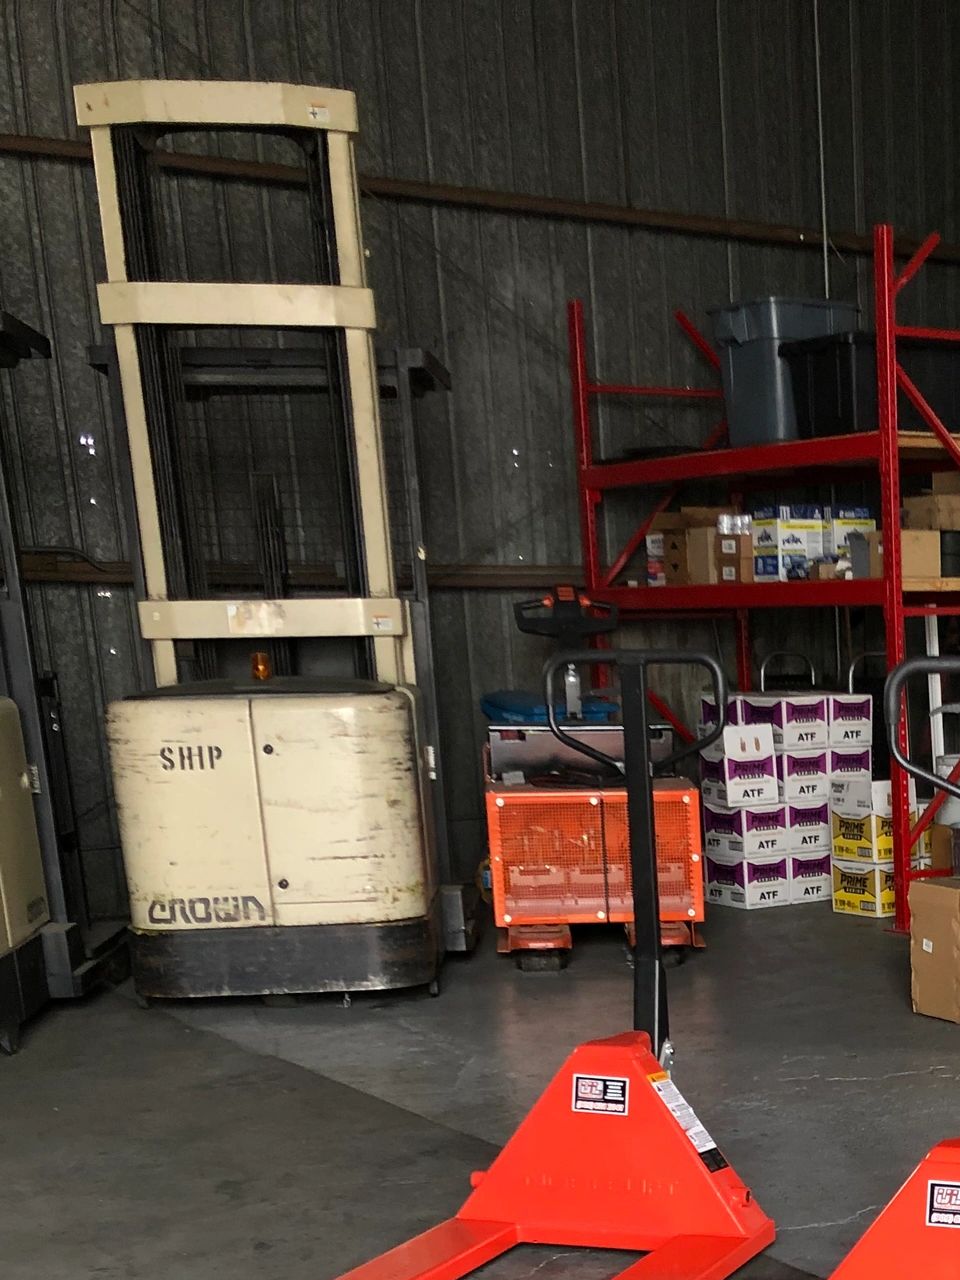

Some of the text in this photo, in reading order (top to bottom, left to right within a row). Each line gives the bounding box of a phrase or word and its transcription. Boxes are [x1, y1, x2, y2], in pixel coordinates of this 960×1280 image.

[797, 732, 817, 743] ATF
[843, 730, 862, 740] ATF
[159, 745, 223, 771] SHIP
[733, 761, 767, 776] PRIME
[742, 788, 765, 799] ATF
[798, 784, 818, 795] ATF
[838, 820, 866, 834] PRIME
[706, 839, 721, 847] ATF
[757, 839, 778, 850] ATF
[801, 835, 821, 846] ATF
[840, 873, 869, 888] PRIME
[709, 889, 723, 898] ATF
[759, 890, 779, 901] ATF
[803, 885, 823, 896] ATF
